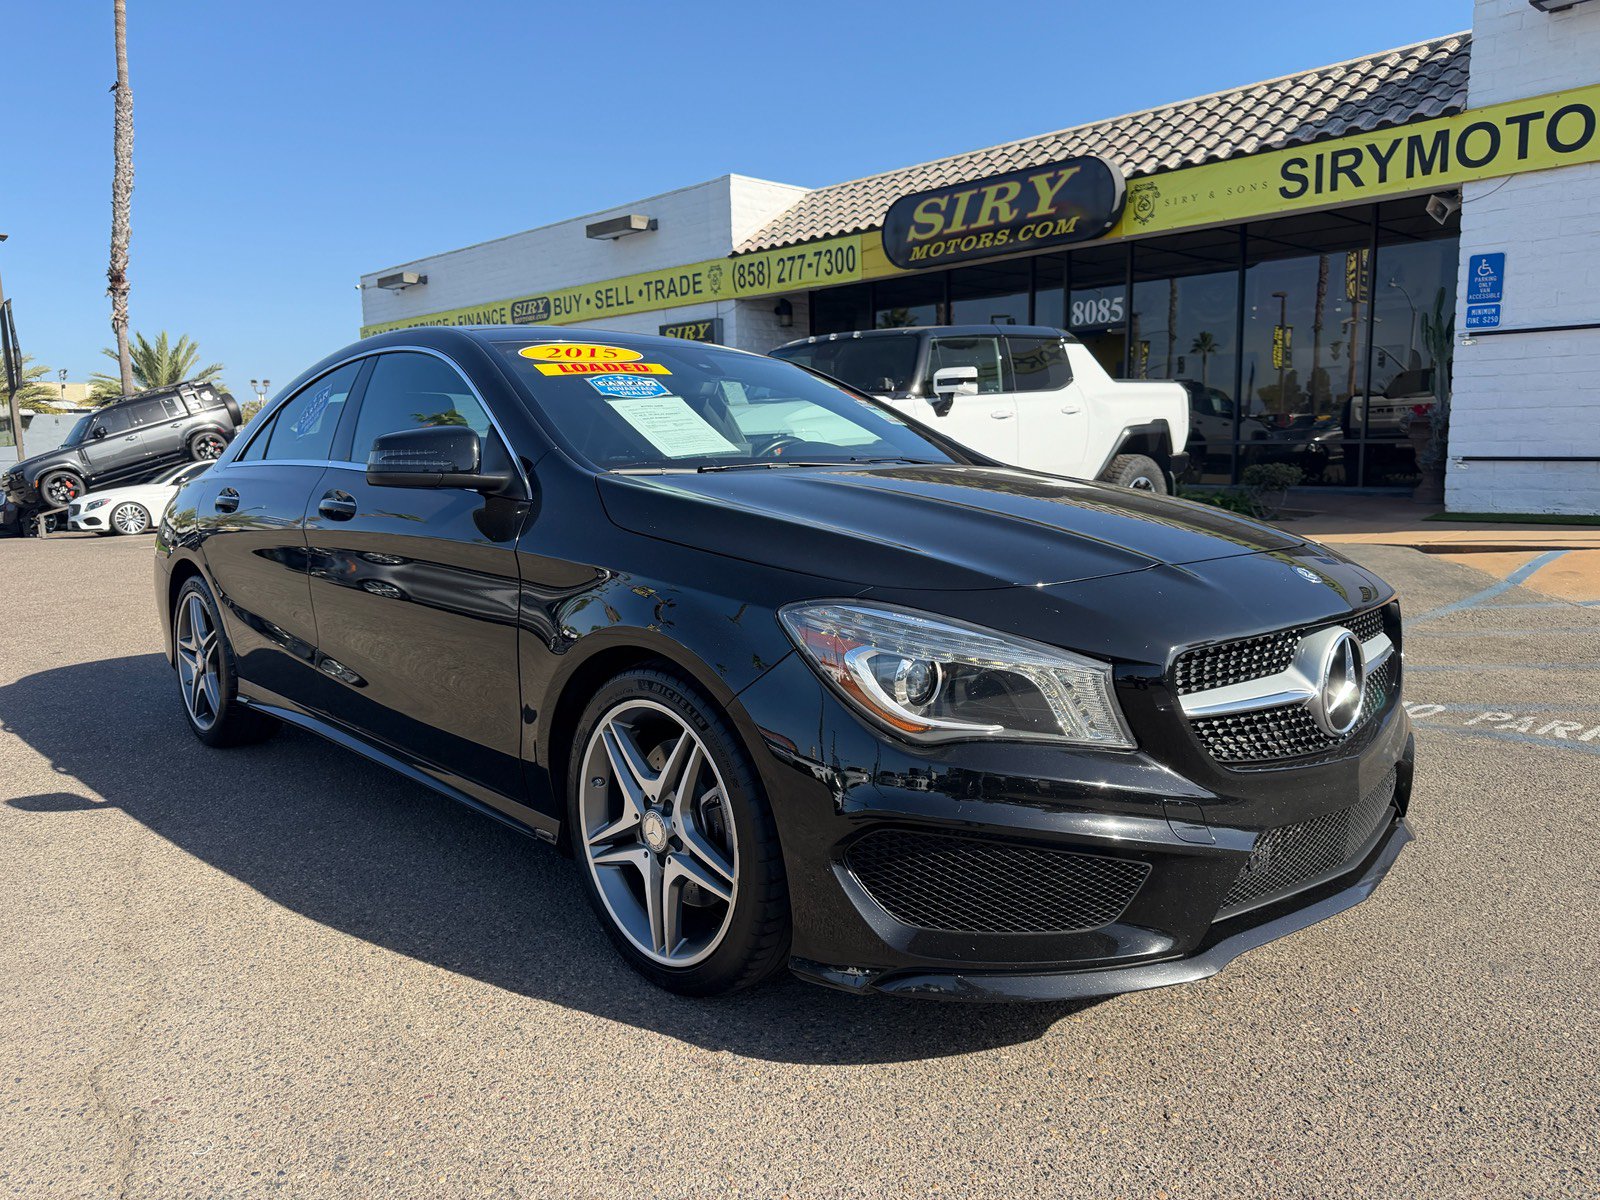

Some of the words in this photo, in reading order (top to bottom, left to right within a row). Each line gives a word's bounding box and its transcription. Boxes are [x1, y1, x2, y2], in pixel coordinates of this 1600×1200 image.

[1278, 103, 1597, 200] SIRYMOTO
[906, 166, 1081, 242] SIRY
[1164, 193, 1198, 207] SIRY
[1208, 190, 1215, 200] &
[1226, 181, 1269, 196] SONS
[908, 216, 1080, 262] MOTORS.COM
[732, 256, 771, 293] (858)
[777, 245, 856, 284] 277-7300
[458, 308, 507, 326] FINANCE
[554, 293, 583, 316] BUY
[595, 285, 634, 310] SELL
[514, 299, 548, 317] SIRY
[1072, 297, 1124, 326] 8085
[665, 322, 711, 340] SIRY
[546, 347, 618, 359] 2015
[558, 362, 654, 374] LOADED
[651, 684, 707, 729] MICHELIN
[1402, 701, 1446, 719] O
